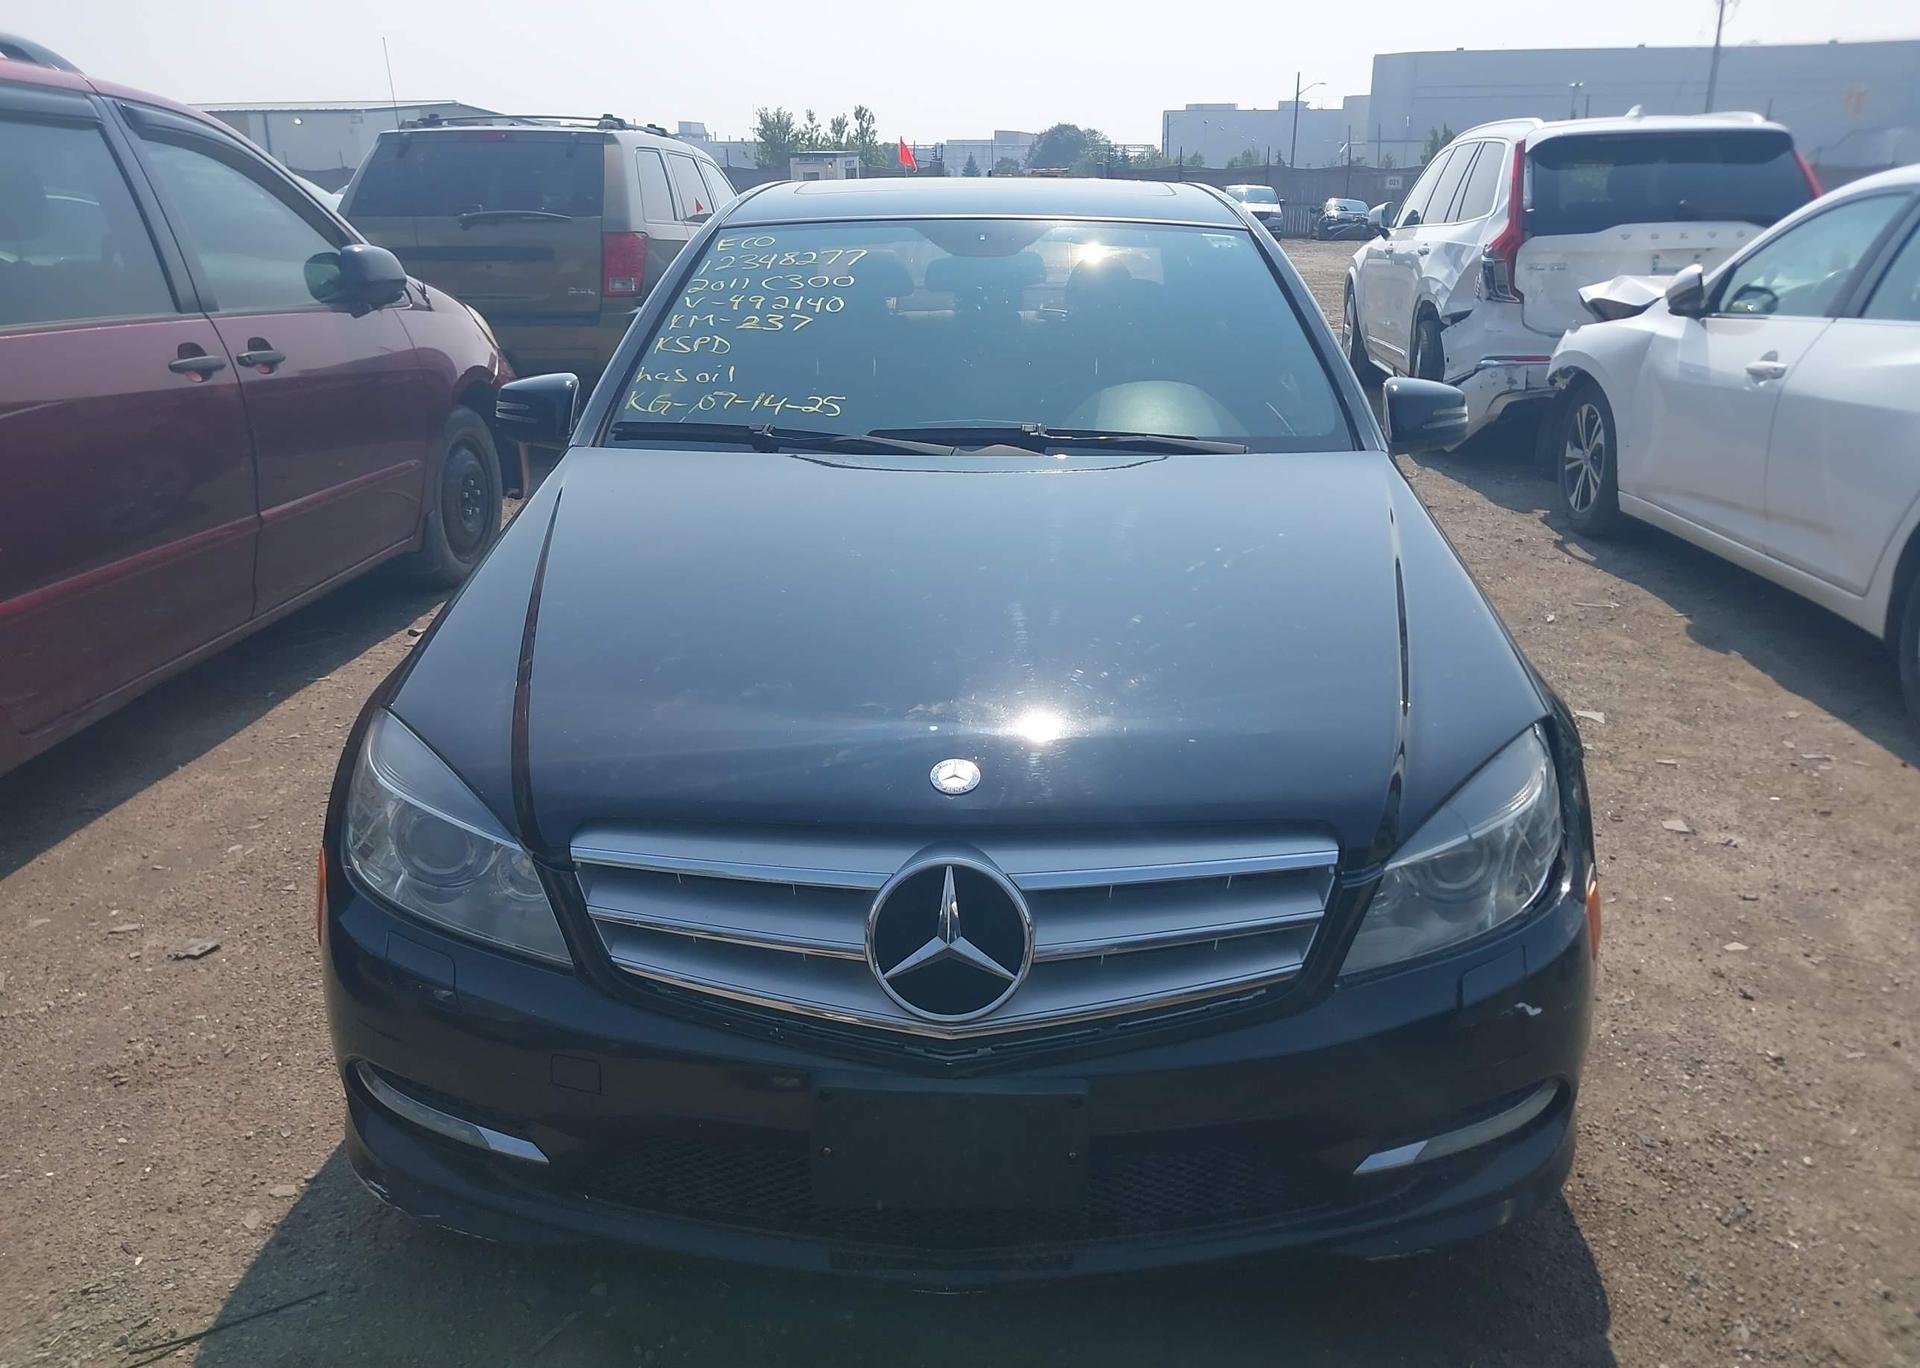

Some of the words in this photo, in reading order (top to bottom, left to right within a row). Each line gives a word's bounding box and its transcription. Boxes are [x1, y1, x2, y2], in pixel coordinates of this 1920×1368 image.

[717, 236, 776, 251] ECO
[698, 249, 868, 276] 12348277
[687, 279, 749, 293] 2011
[761, 274, 855, 290] C300
[653, 336, 731, 354] KSPD
